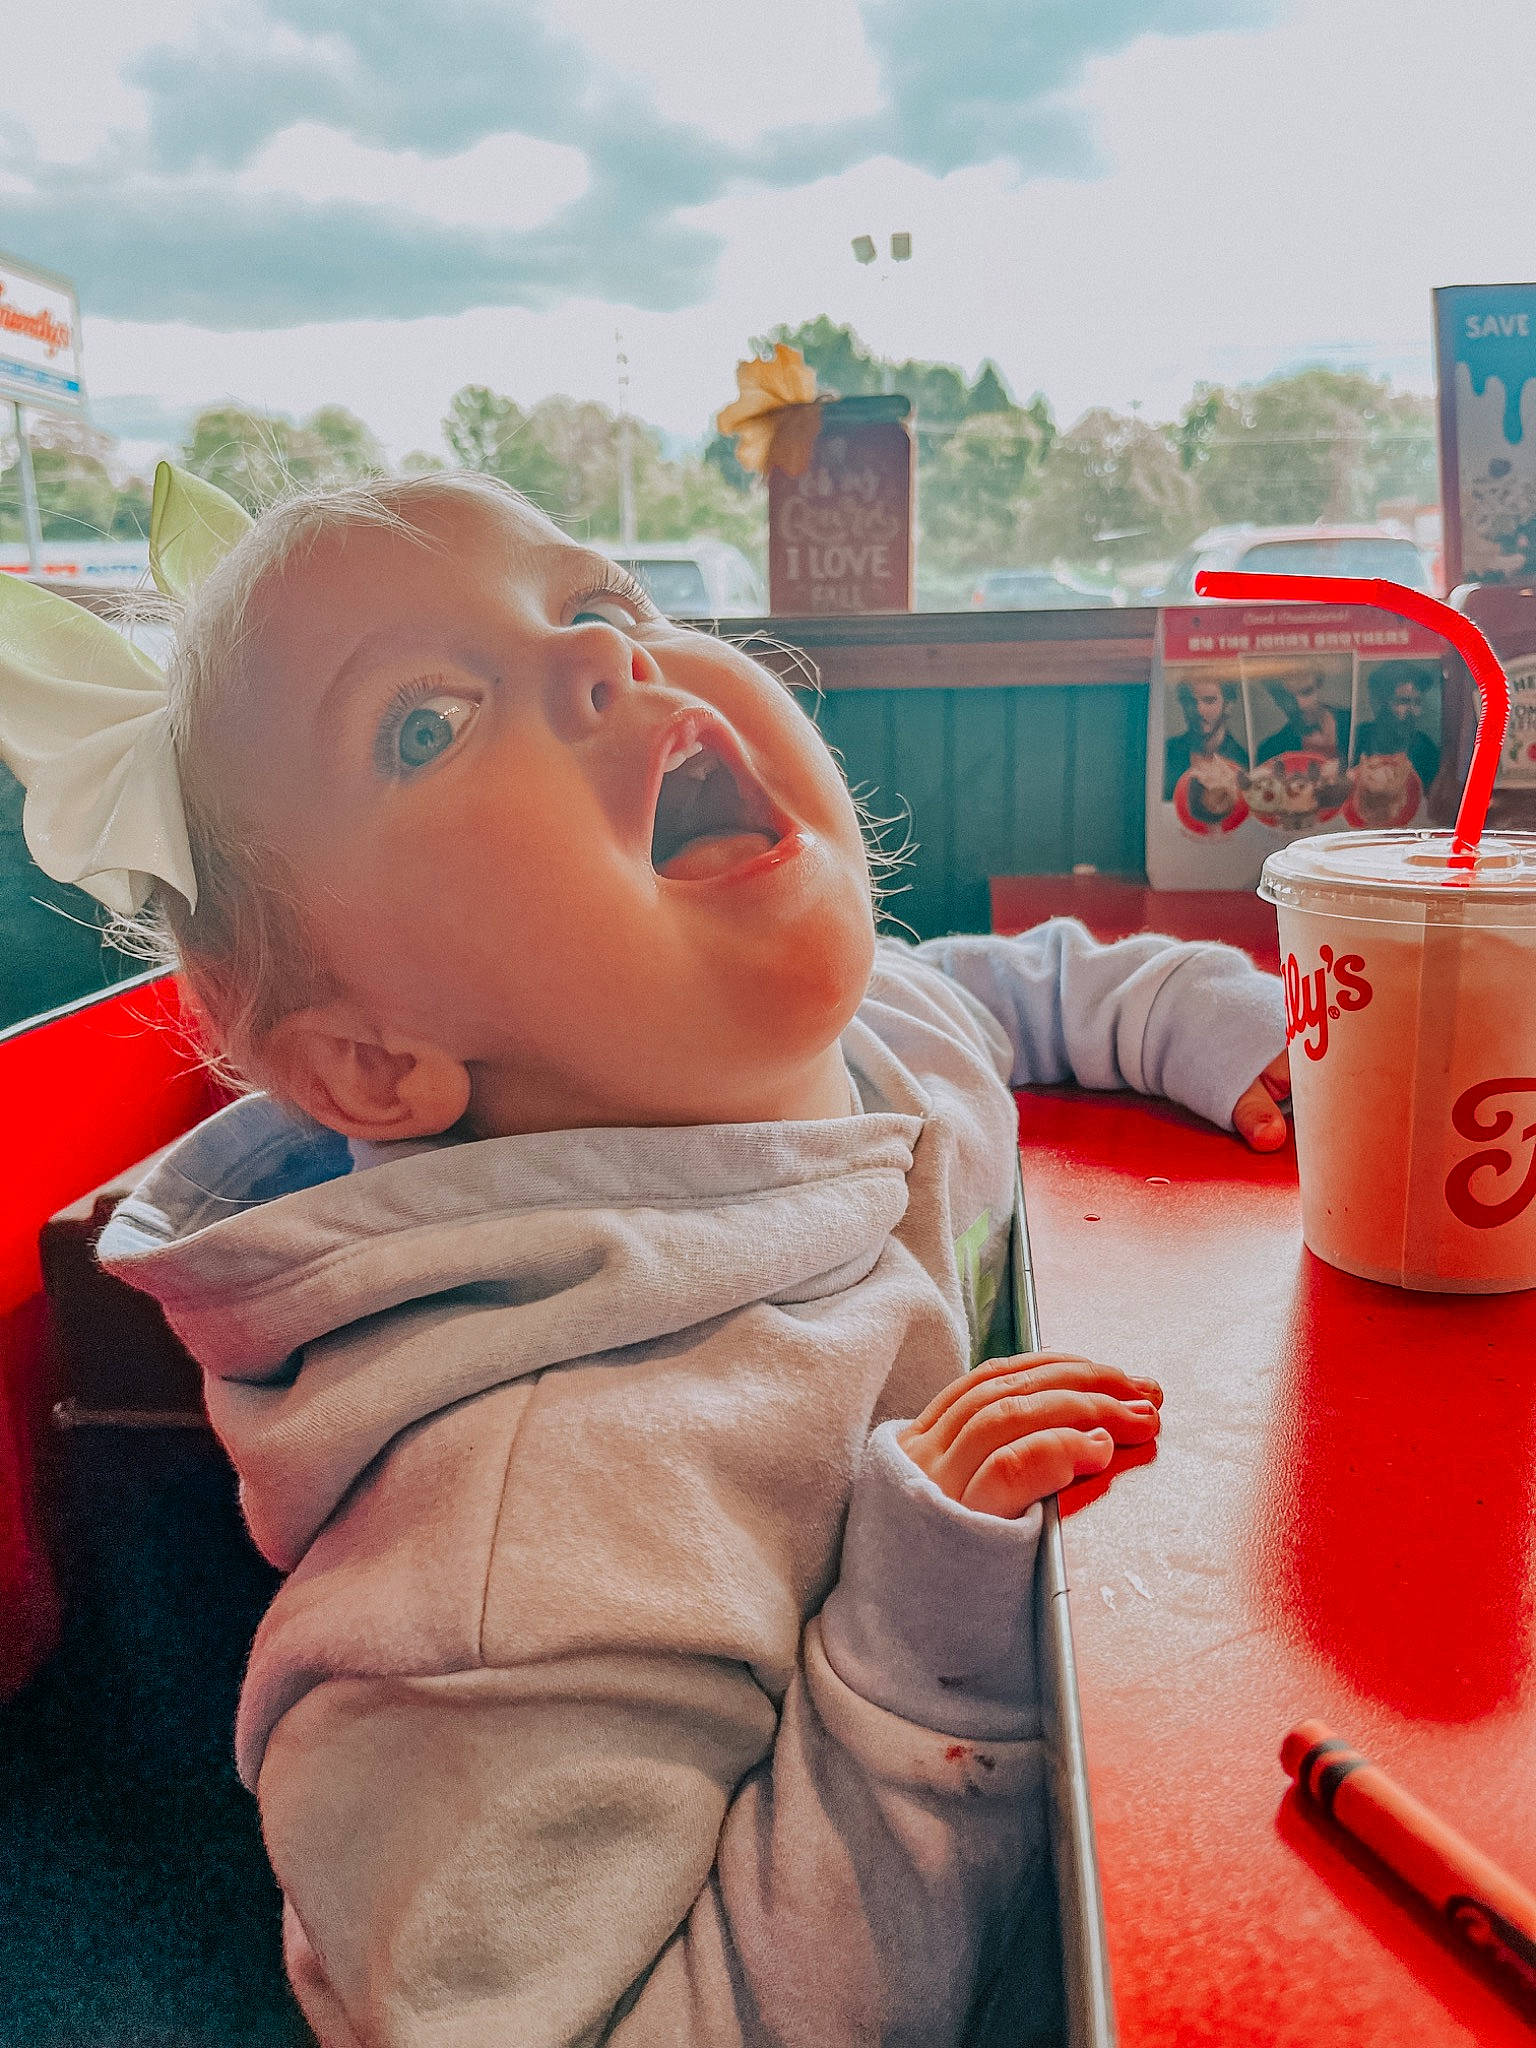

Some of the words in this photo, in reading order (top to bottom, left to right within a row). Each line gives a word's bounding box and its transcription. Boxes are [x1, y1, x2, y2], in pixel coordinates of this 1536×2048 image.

[1465, 314, 1529, 338] SAVE
[786, 548, 799, 579] I
[808, 545, 890, 579] LOVE
[1314, 629, 1409, 646] BROTHERS
